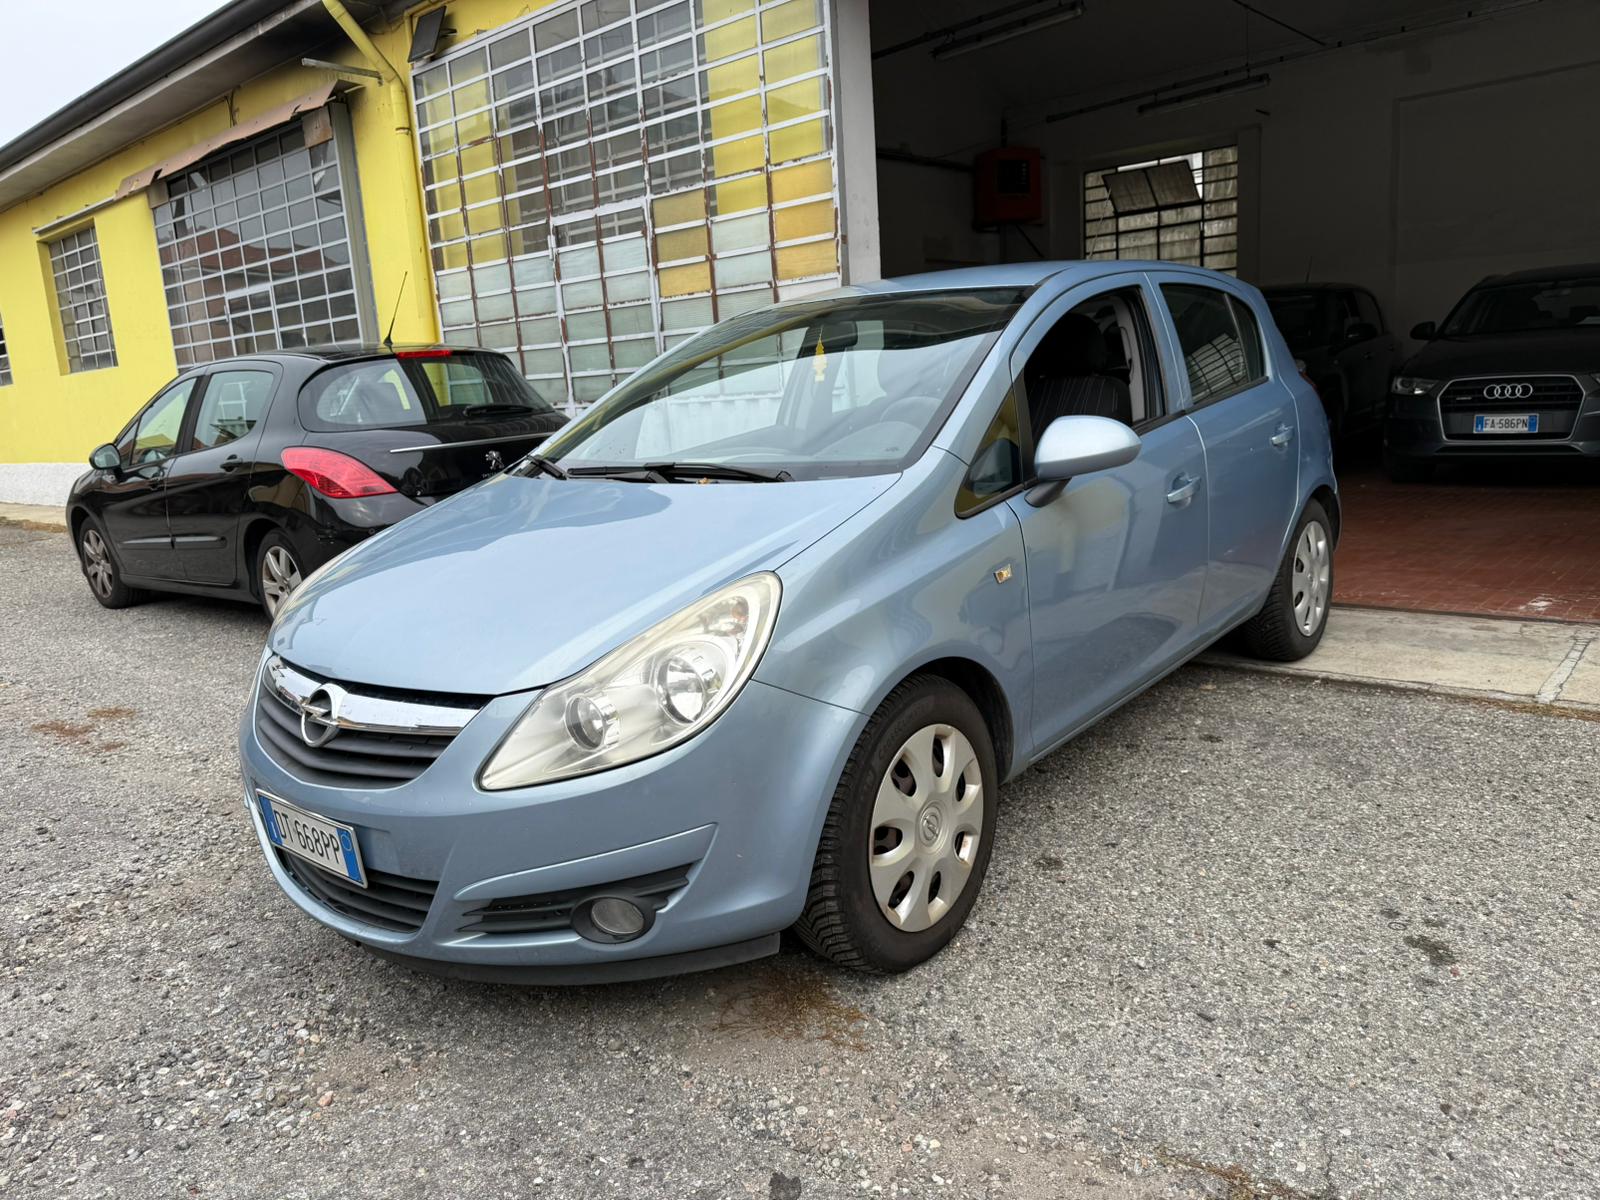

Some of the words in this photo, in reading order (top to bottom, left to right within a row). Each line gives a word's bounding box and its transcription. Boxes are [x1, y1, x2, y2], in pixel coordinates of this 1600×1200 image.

[1484, 418, 1496, 428] FA
[1498, 418, 1528, 429] 586PN
[273, 810, 294, 843] DT
[294, 820, 340, 864] 668PP
